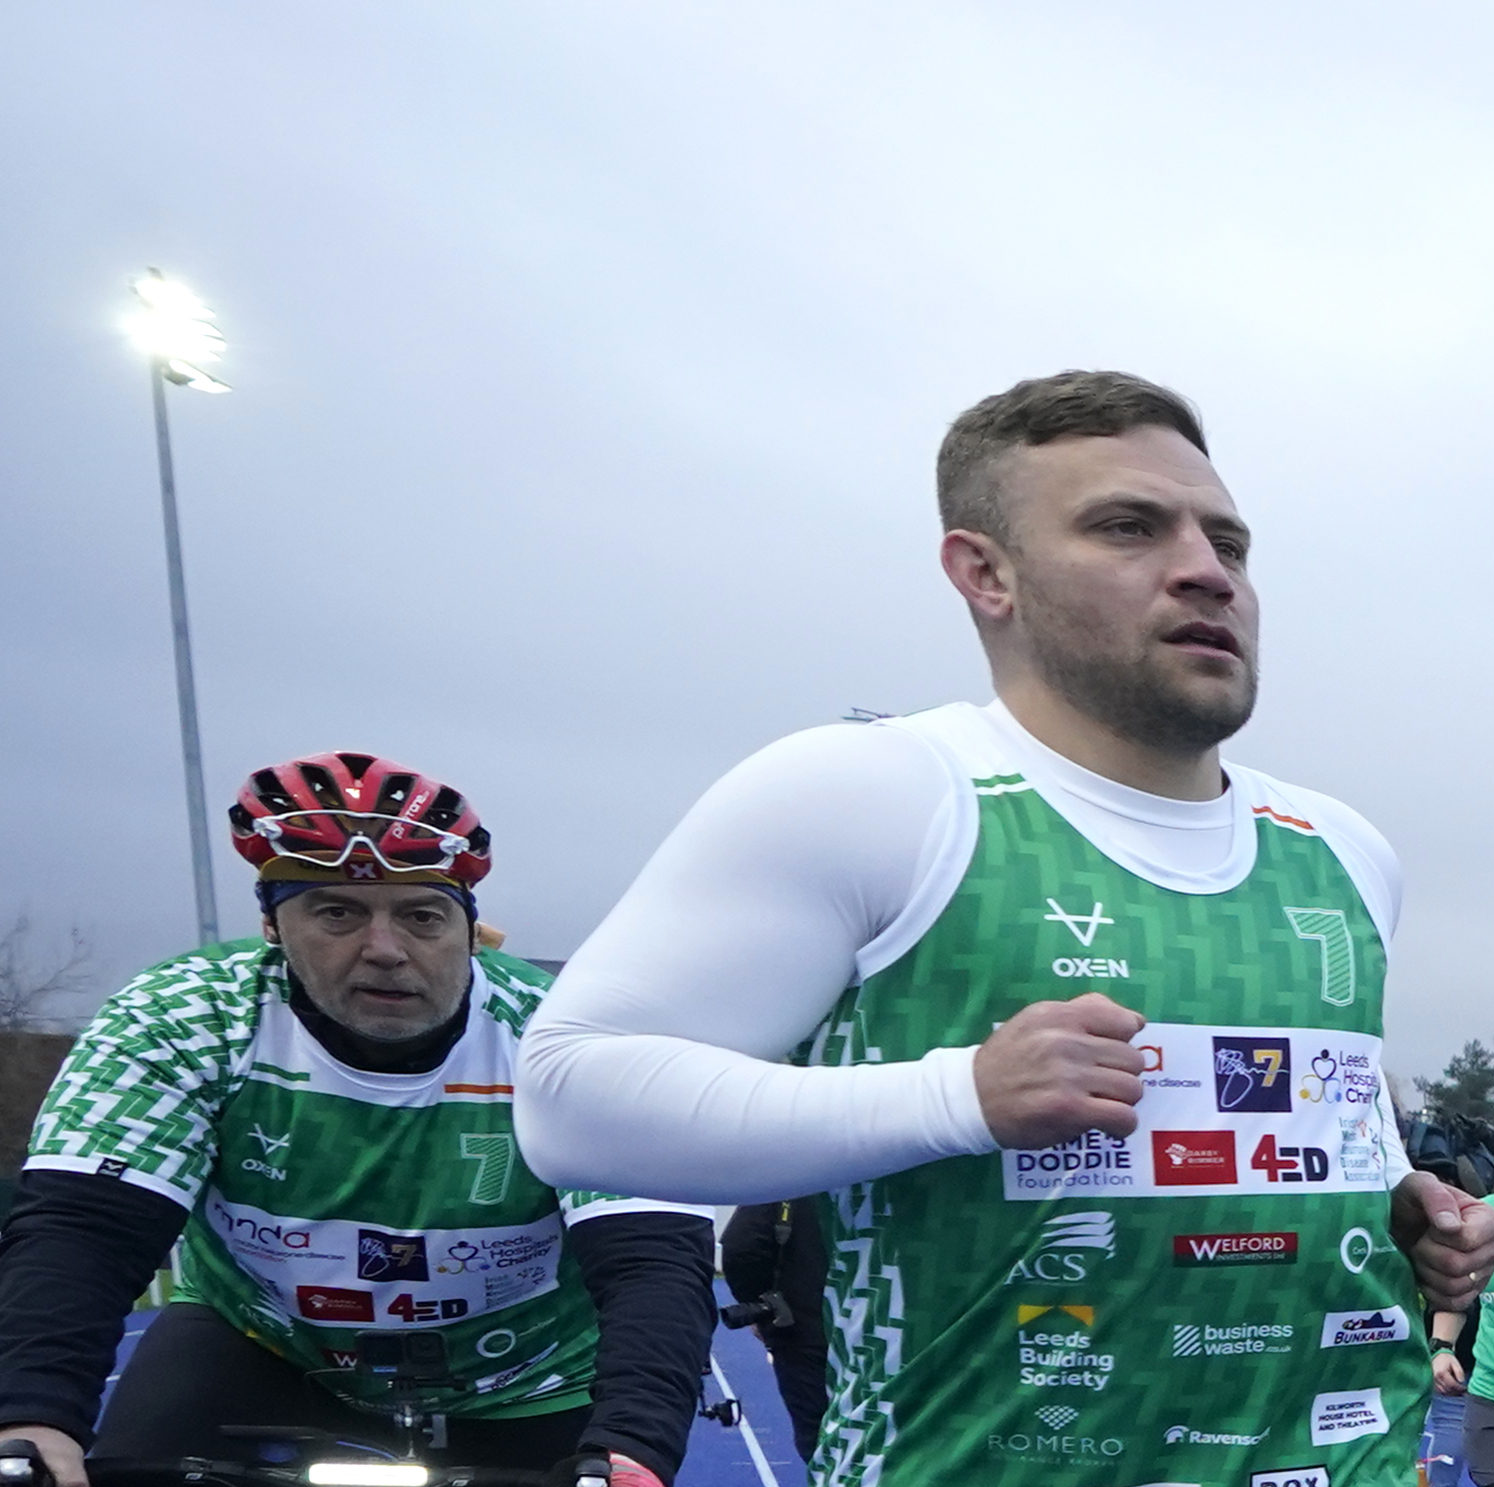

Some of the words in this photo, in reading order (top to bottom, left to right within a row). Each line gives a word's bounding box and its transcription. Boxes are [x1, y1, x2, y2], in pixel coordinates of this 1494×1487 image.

[1052, 957, 1130, 980] OXEN
[241, 1158, 287, 1181] OXEN
[460, 1132, 515, 1205] 7
[1016, 1151, 1132, 1172] DODDIE
[1017, 1172, 1134, 1189] foundation
[481, 1235, 534, 1250] Leeds
[1190, 1237, 1285, 1261] WELFORD
[1004, 1253, 1086, 1285] ACS
[1018, 1329, 1091, 1349] Leeds
[1204, 1322, 1294, 1341] business
[1333, 1329, 1397, 1345] BUNKABIN
[1019, 1347, 1115, 1372] Building
[1020, 1367, 1110, 1391] Society
[987, 1434, 1124, 1456] ROMERO
